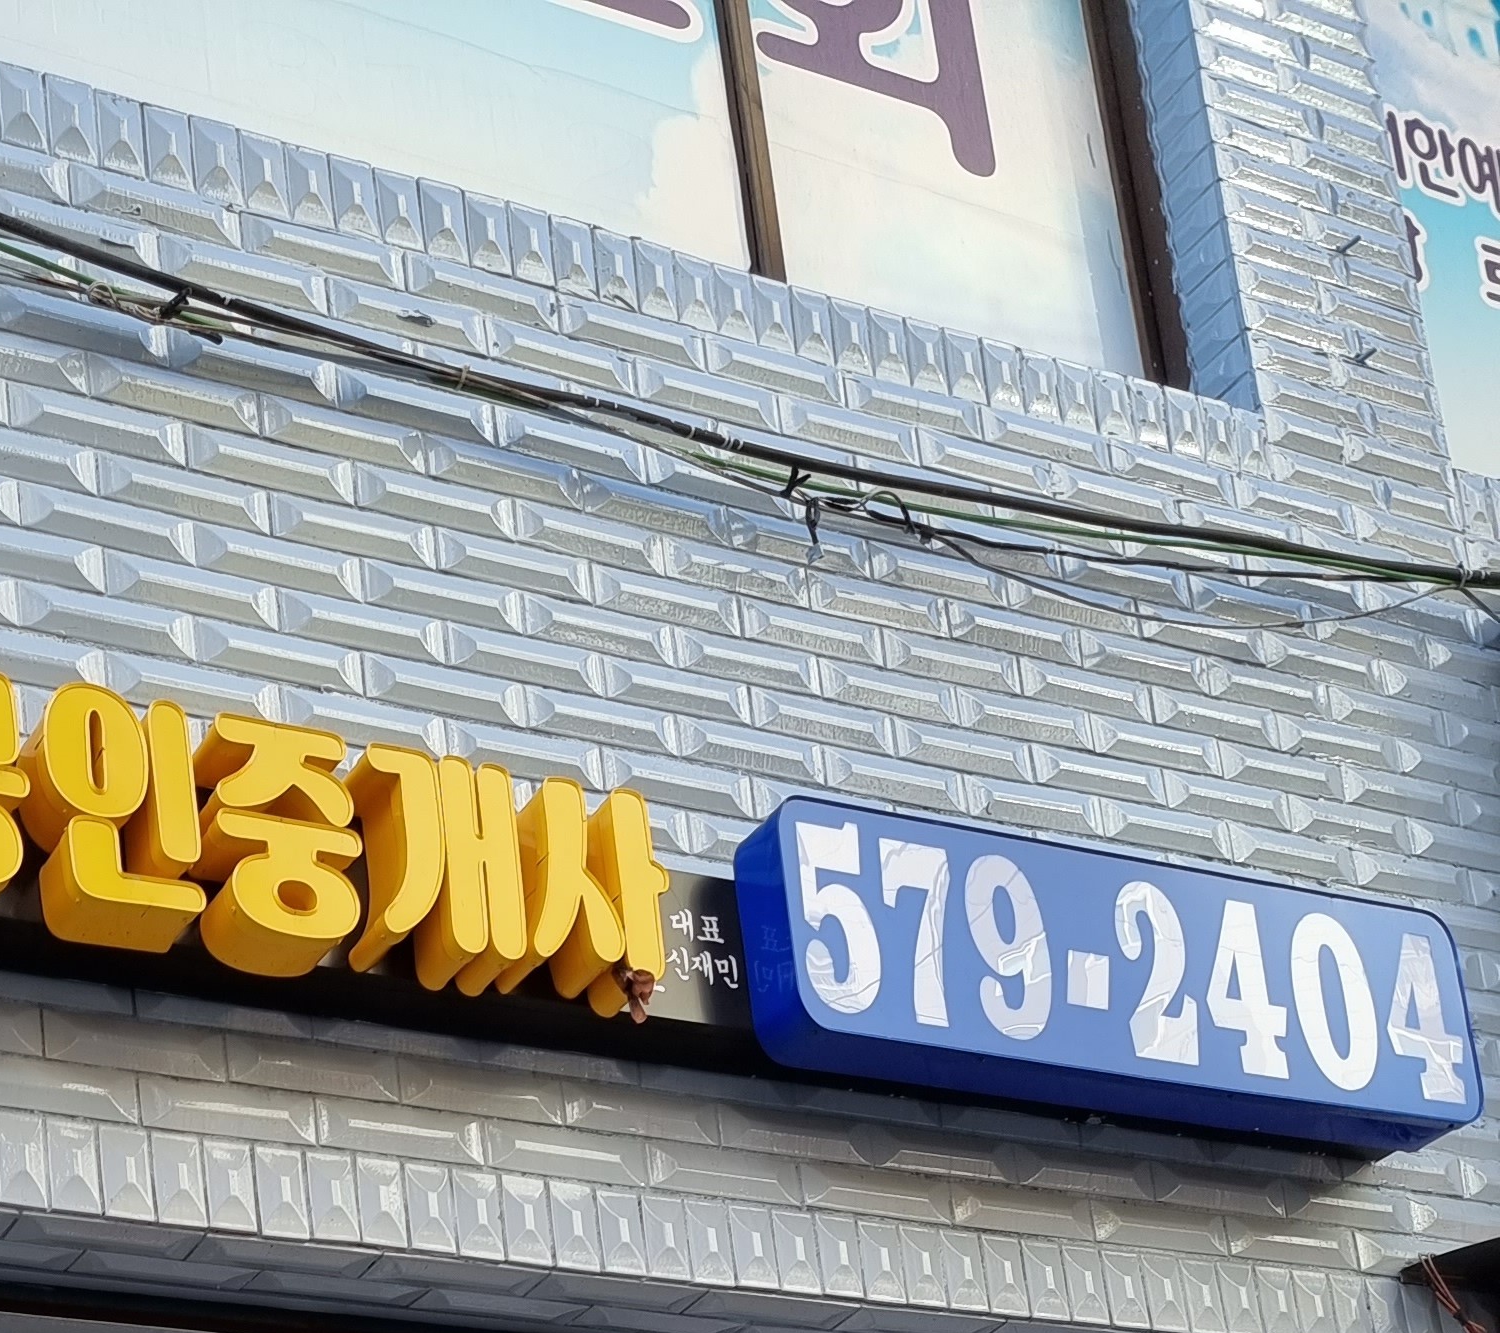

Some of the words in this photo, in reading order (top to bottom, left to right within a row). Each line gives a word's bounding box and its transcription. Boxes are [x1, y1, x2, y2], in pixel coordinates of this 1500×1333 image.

[669, 908, 725, 944] 대표
[666, 946, 739, 989] 신재민
[796, 818, 1467, 1106] 579-2404
